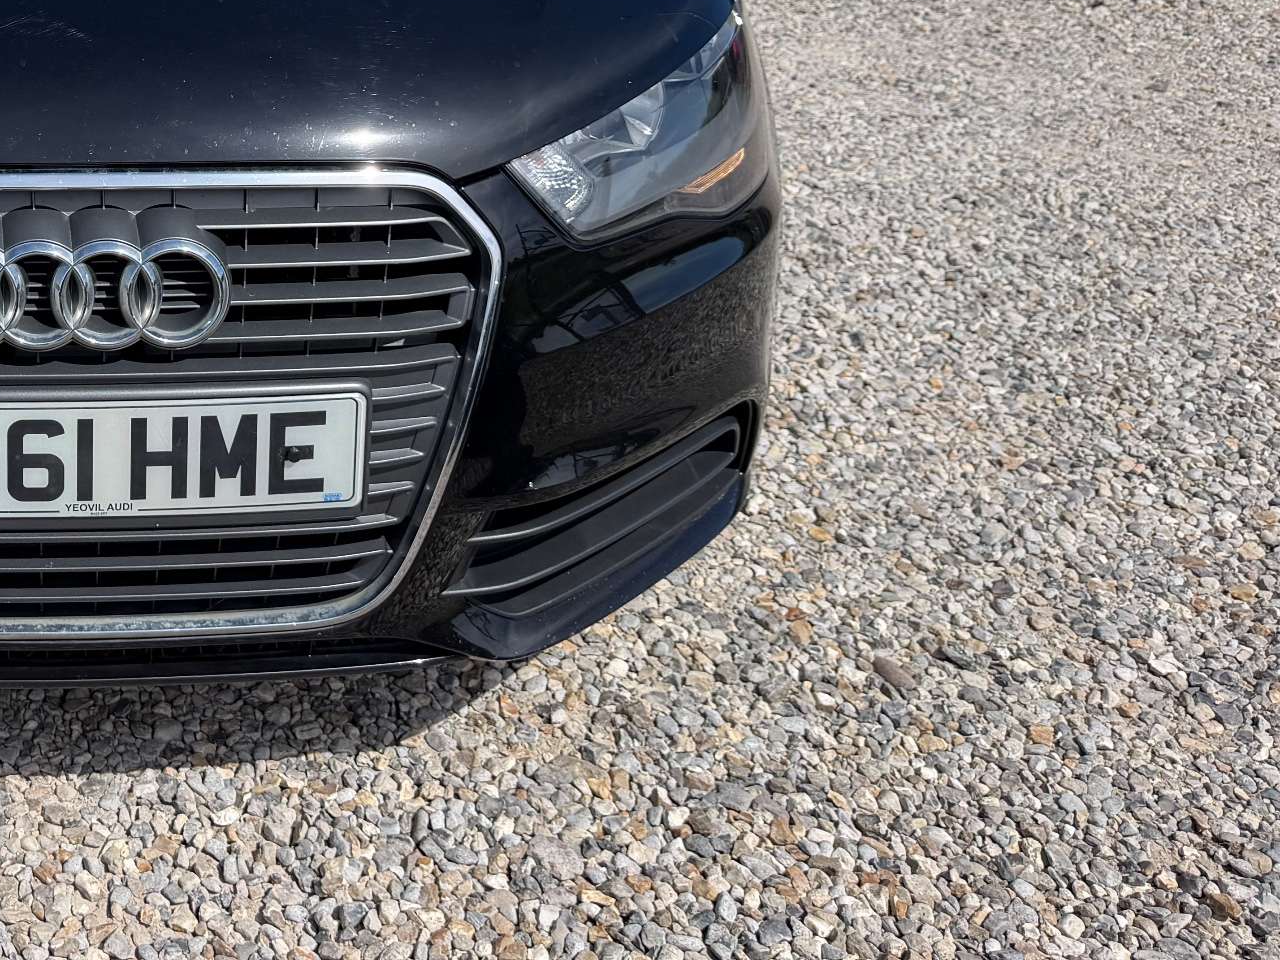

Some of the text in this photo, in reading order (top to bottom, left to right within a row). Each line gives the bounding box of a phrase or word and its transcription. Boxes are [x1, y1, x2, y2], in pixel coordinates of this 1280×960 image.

[130, 411, 326, 501] HME
[65, 502, 133, 512] YEOVIL AUDI
